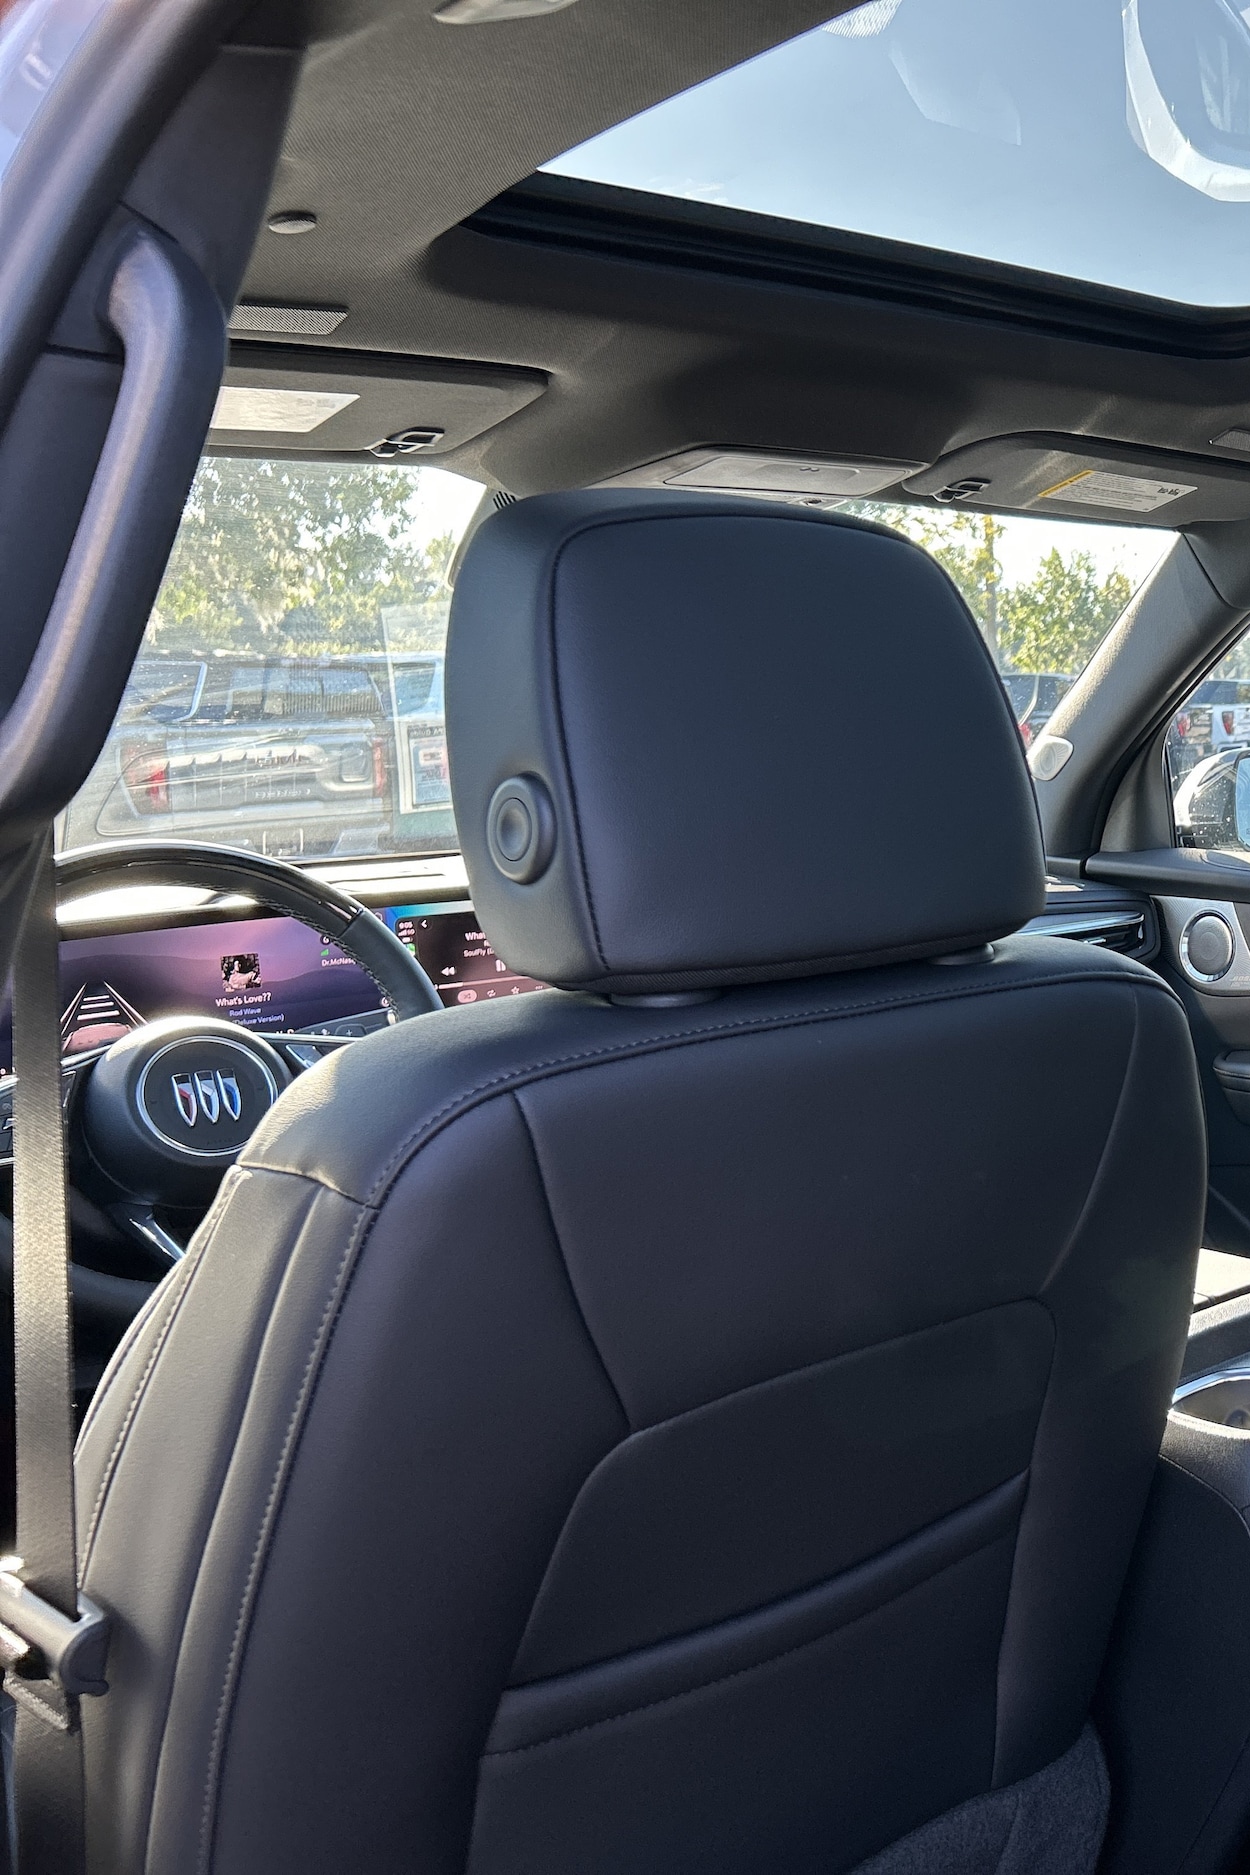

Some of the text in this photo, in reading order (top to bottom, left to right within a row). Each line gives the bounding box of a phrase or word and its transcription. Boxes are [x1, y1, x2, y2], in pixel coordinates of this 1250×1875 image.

[215, 992, 272, 1007] What's Love??
[229, 1008, 262, 1017] Rod Wave
[257, 1013, 284, 1024] Version)
